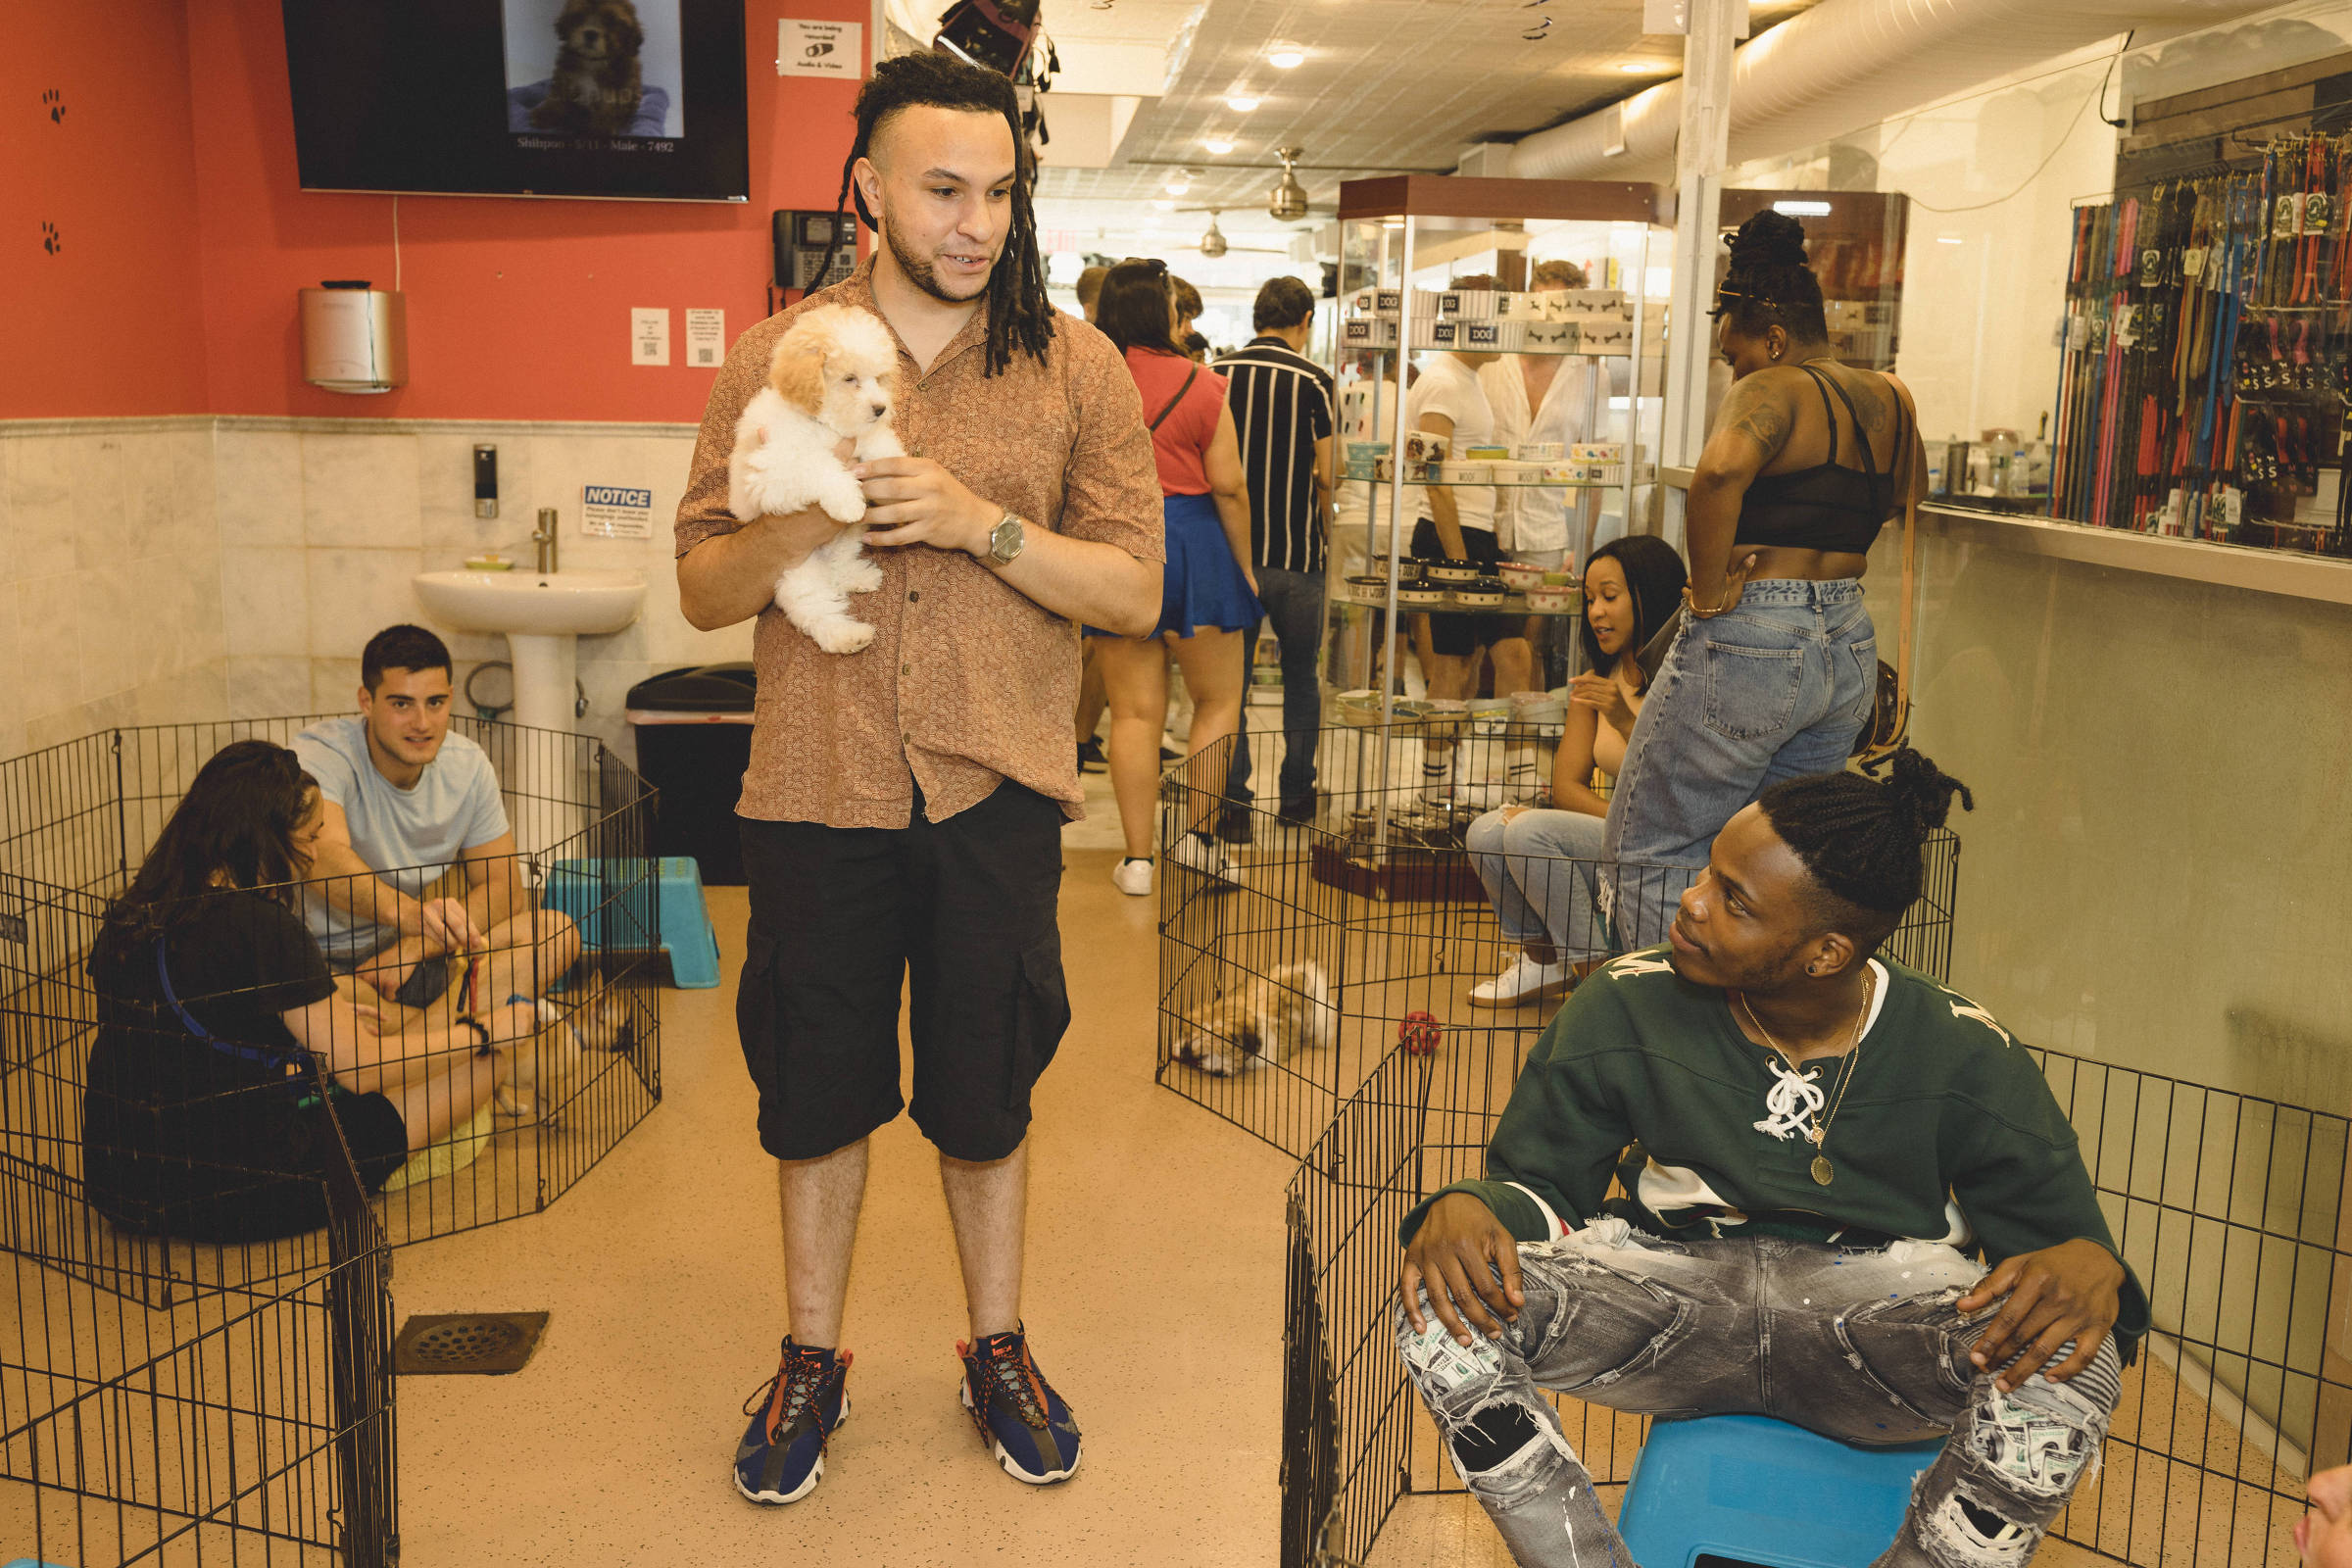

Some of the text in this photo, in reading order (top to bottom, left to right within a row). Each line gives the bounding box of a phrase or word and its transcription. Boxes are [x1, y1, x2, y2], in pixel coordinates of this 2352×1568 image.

[611, 140, 638, 152] Male
[647, 141, 674, 153] 7492
[1379, 296, 1398, 307] DOG
[1348, 324, 1366, 335] DOG
[1472, 328, 1494, 339] DOG
[2264, 376, 2273, 389] S
[2281, 371, 2291, 385] S
[2306, 377, 2315, 390] S
[2268, 466, 2278, 479] S
[586, 488, 649, 507] NOTICE
